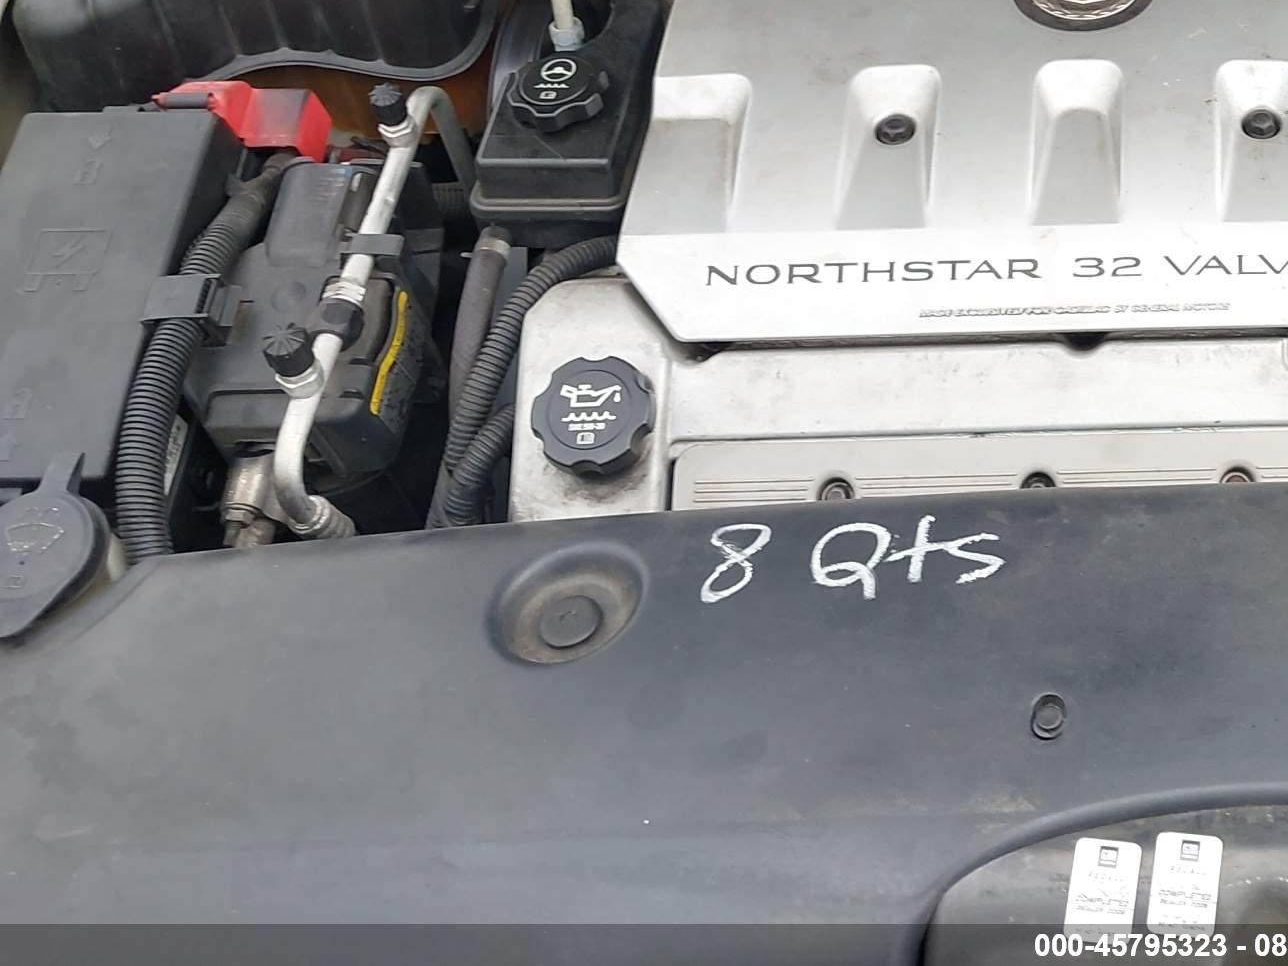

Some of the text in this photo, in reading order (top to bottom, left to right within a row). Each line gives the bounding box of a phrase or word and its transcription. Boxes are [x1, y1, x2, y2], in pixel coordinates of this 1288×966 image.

[706, 258, 1042, 286] NORTHSTAR
[1072, 256, 1142, 278] 32
[700, 514, 1006, 604] 8 Qts
